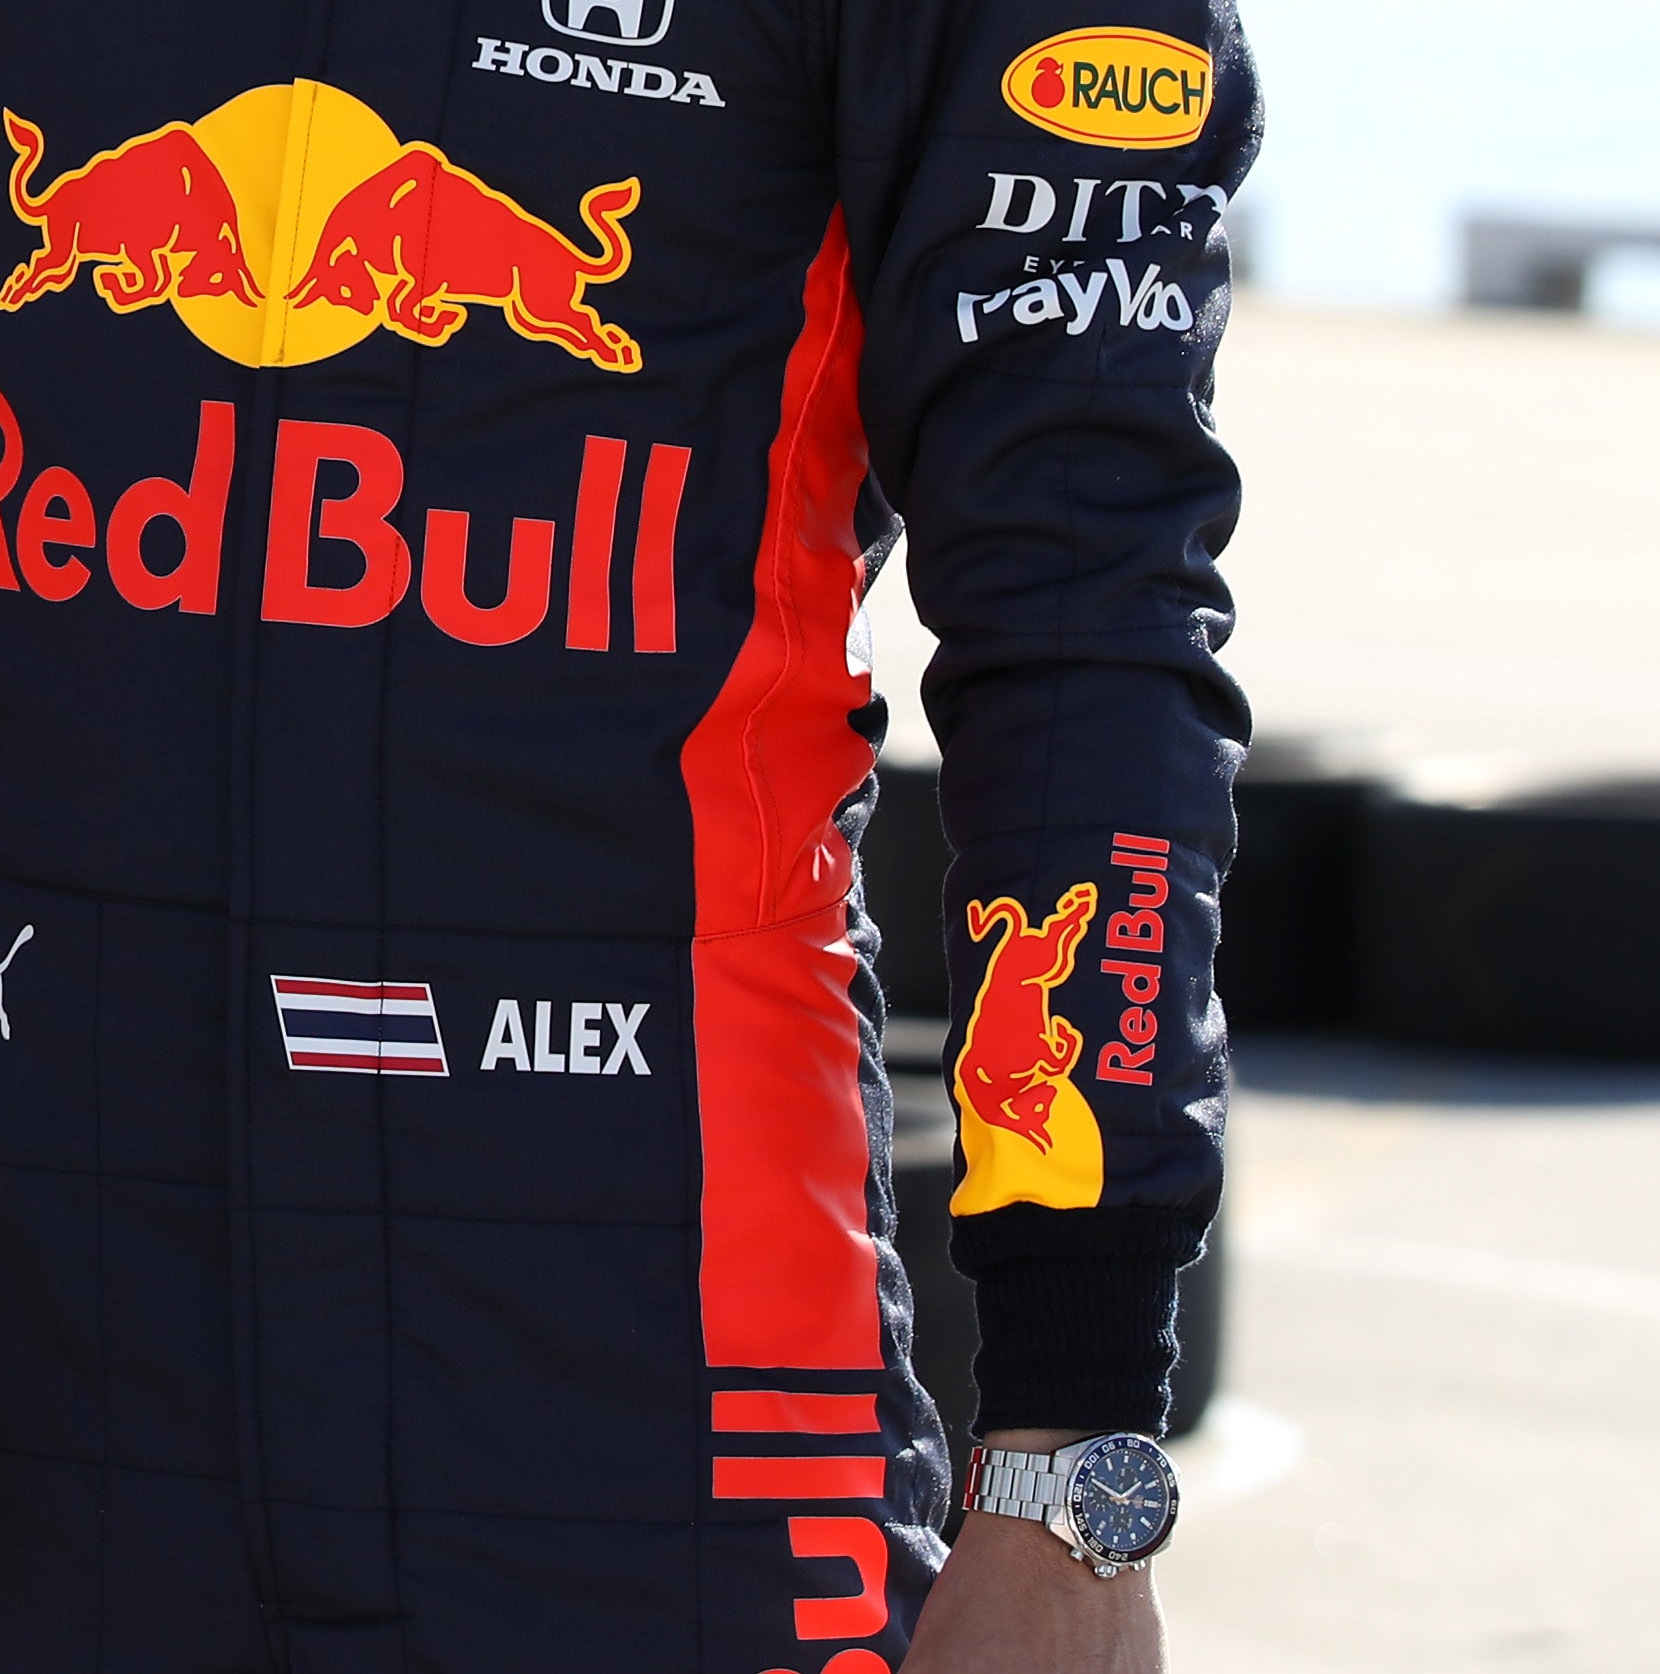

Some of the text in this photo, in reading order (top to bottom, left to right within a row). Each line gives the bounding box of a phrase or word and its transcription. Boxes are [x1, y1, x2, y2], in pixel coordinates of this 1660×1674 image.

[471, 37, 726, 108] HONDA
[1071, 61, 1207, 118] RAUCH
[260, 417, 692, 654] Bull
[479, 998, 652, 1076] ALEX
[1095, 832, 1171, 1086] Red Bull
[710, 1390, 891, 1674] ull
